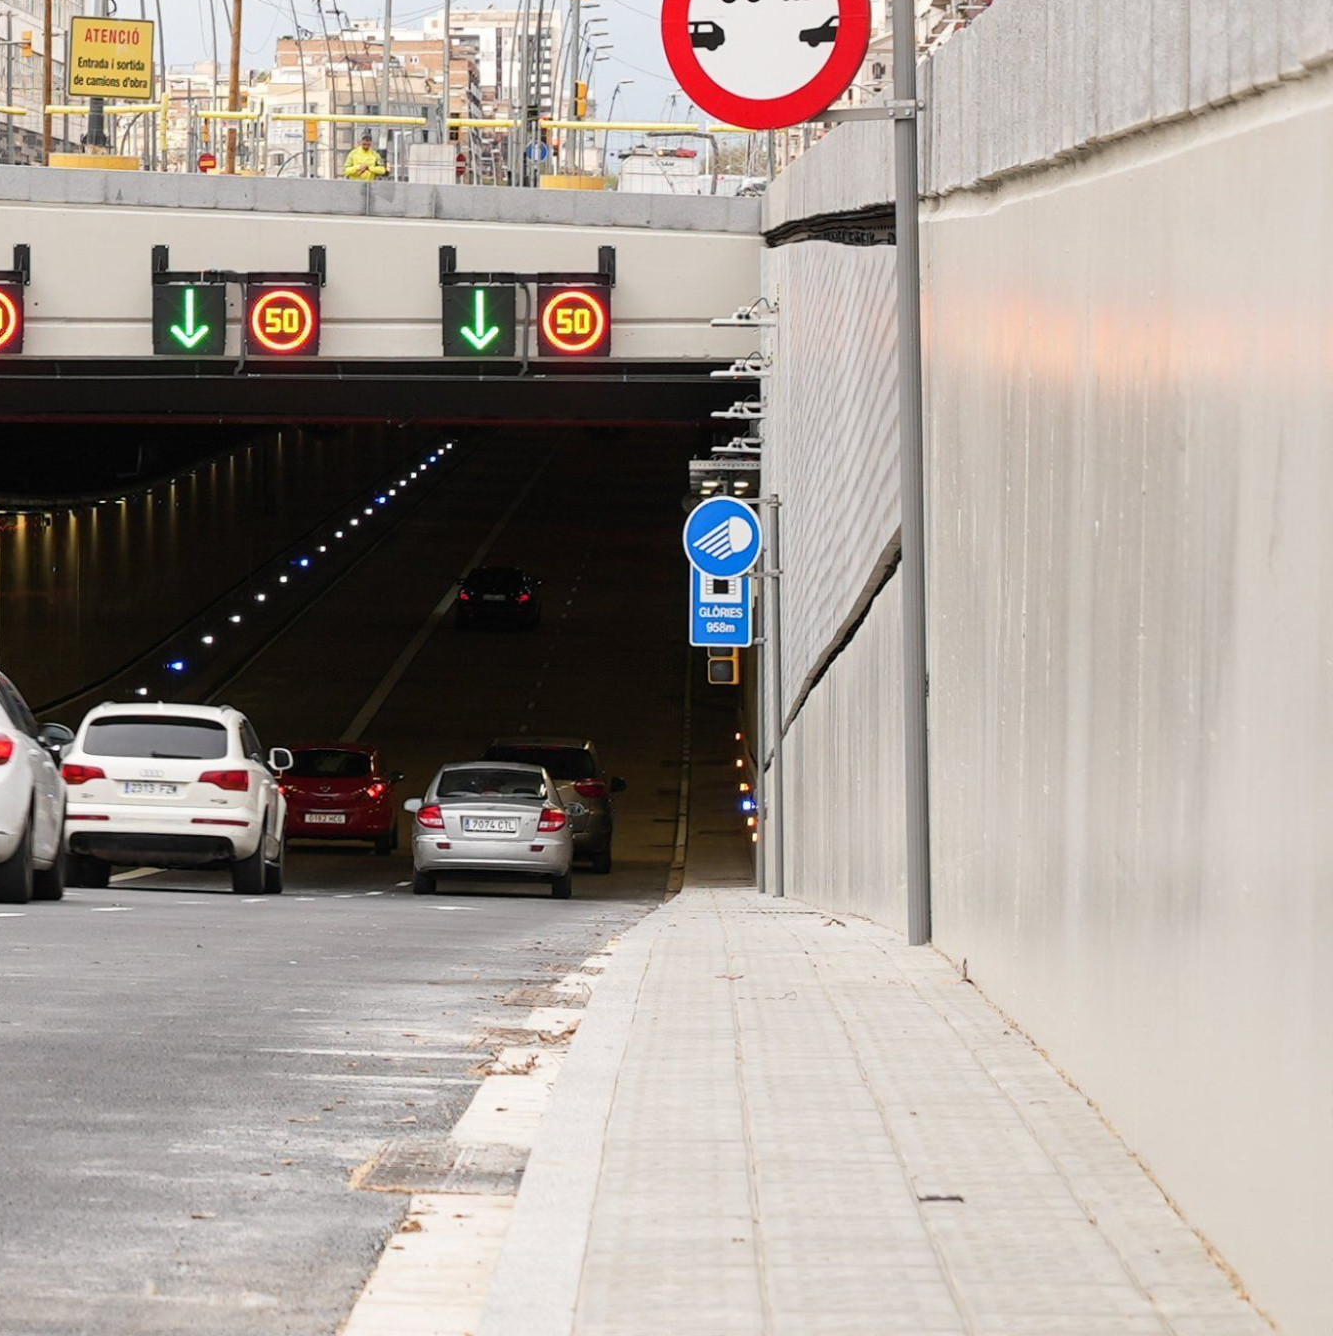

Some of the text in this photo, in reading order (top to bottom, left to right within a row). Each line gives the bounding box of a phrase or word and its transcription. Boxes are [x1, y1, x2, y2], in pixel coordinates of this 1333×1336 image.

[84, 27, 140, 45] ATENCIÓ
[77, 56, 109, 69] Entrada
[116, 59, 145, 71] sortida
[73, 73, 84, 86] de
[122, 76, 148, 89] d'obra
[264, 307, 300, 334] 50
[556, 308, 591, 335] 50
[472, 820, 495, 829] 7074
